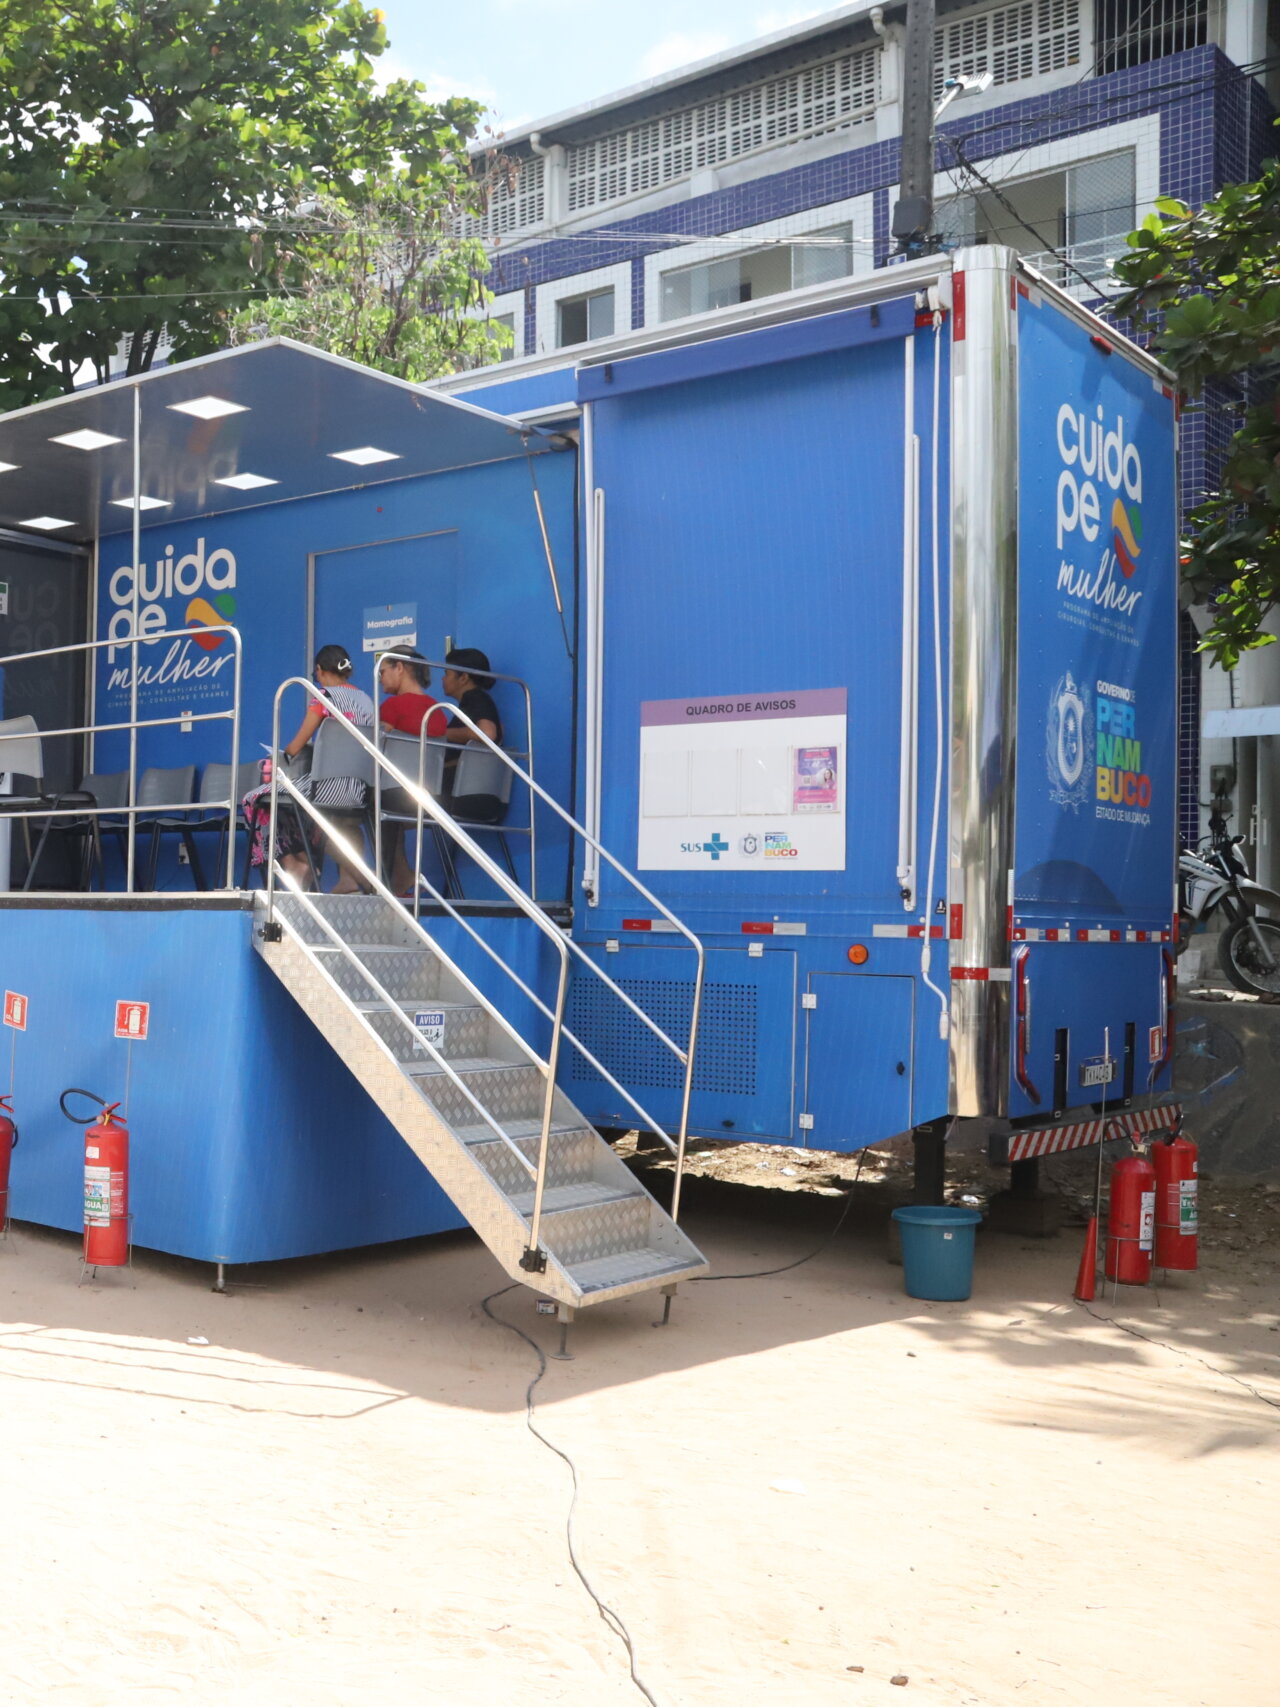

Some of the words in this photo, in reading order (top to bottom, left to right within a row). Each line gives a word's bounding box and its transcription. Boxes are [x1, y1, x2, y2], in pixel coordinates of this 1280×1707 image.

[1057, 403, 1142, 504] cuida
[1057, 470, 1100, 550] pe
[109, 537, 236, 606] cuida
[1056, 547, 1142, 617] mulher
[108, 603, 167, 664] pe
[367, 615, 413, 629] Mamografia
[107, 639, 235, 690] mulher
[686, 704, 733, 716] QUADRO
[736, 702, 751, 713] DE
[754, 699, 796, 712] AVISOS
[1096, 680, 1131, 701] GOVERNO
[1096, 696, 1136, 740] PER
[1096, 731, 1141, 774] NAM
[1096, 765, 1151, 808] BUCO
[1095, 806, 1116, 820] ESTADO
[1117, 810, 1125, 822] DE
[1125, 812, 1151, 828] MUDANÇA
[680, 842, 702, 853] SUS
[765, 835, 789, 843] PER
[419, 1015, 440, 1025] AVISO
